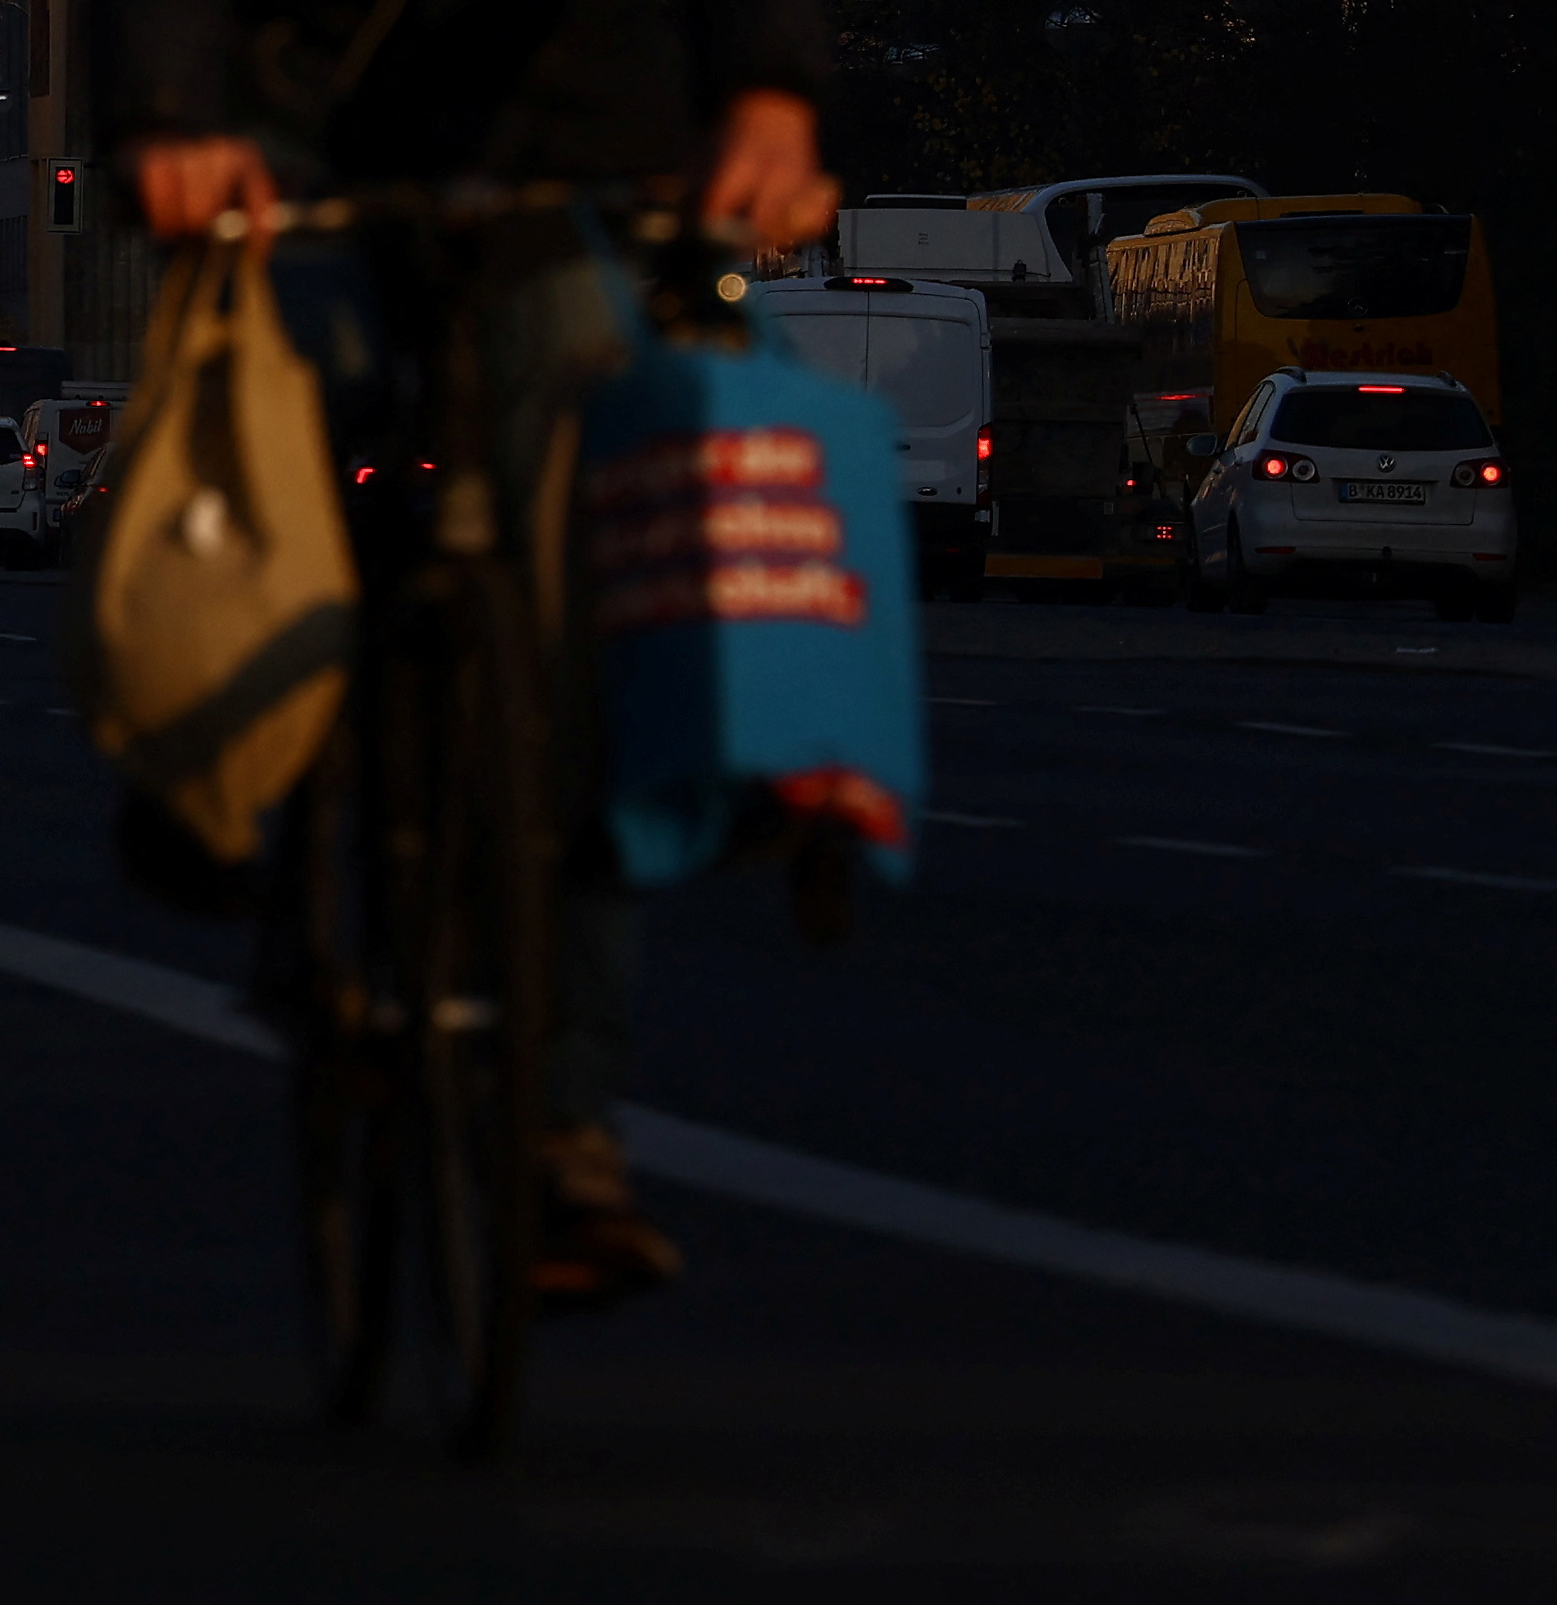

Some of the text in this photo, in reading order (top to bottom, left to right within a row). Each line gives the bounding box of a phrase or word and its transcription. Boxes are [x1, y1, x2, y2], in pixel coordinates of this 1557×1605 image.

[1349, 482, 1422, 499] B KA 8914
